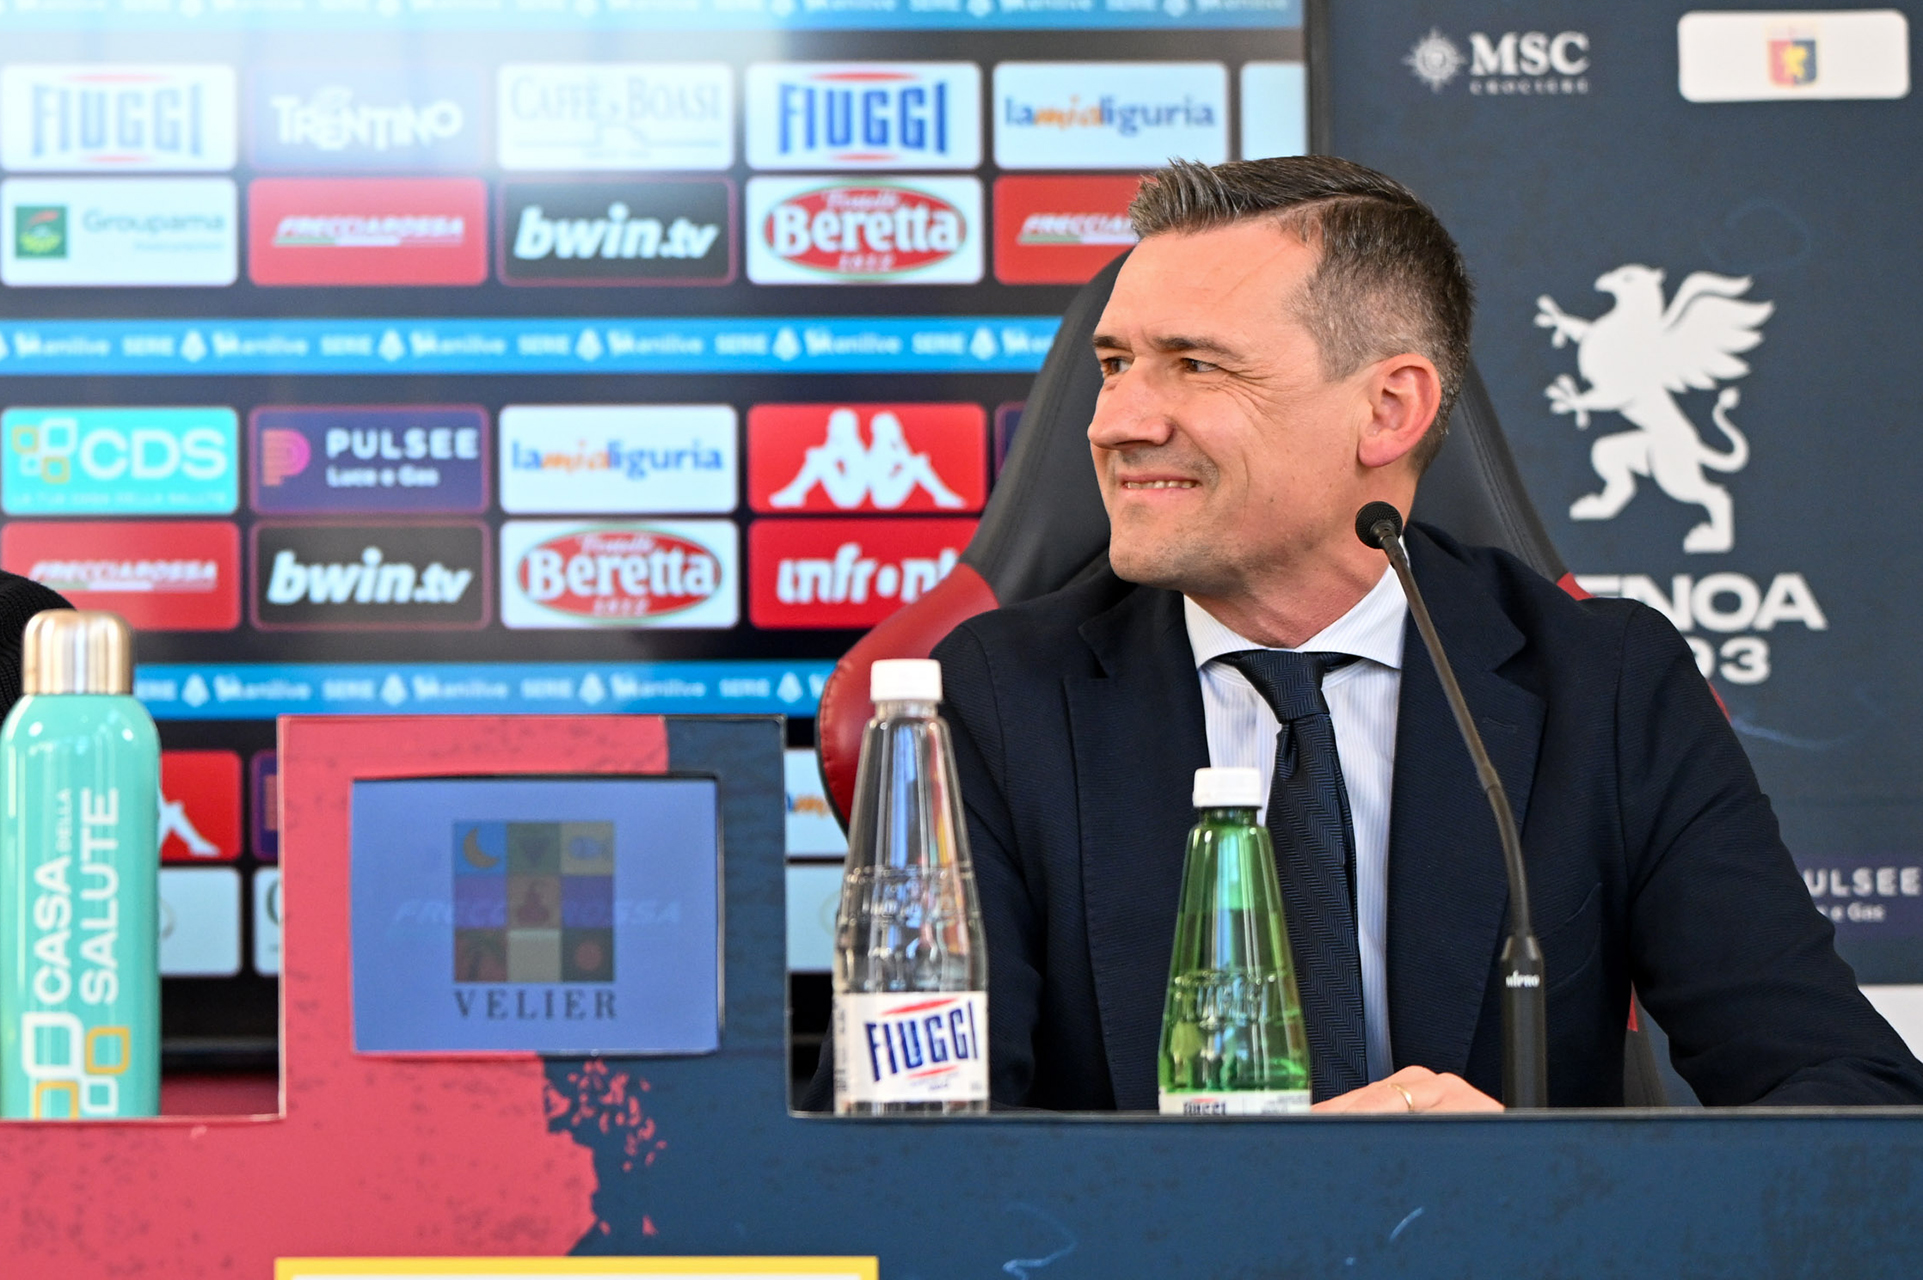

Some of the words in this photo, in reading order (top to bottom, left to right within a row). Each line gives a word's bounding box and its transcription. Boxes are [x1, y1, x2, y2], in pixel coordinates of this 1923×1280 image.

[1469, 31, 1591, 77] MSC
[32, 84, 202, 158] FIUGGI
[778, 81, 948, 156] FIUGGI
[514, 204, 718, 259] bwin.tv
[774, 203, 961, 256] Beretta
[80, 428, 229, 481] CDS
[325, 427, 479, 461] PULSEE
[266, 546, 475, 604] bwin.tv
[526, 546, 716, 602] Beretta
[79, 788, 119, 1005] SALUTE
[1802, 866, 1920, 898] ULSEE
[34, 858, 72, 1005] CASA
[454, 988, 618, 1021] VELIER
[865, 1001, 978, 1082] FIUGGI
